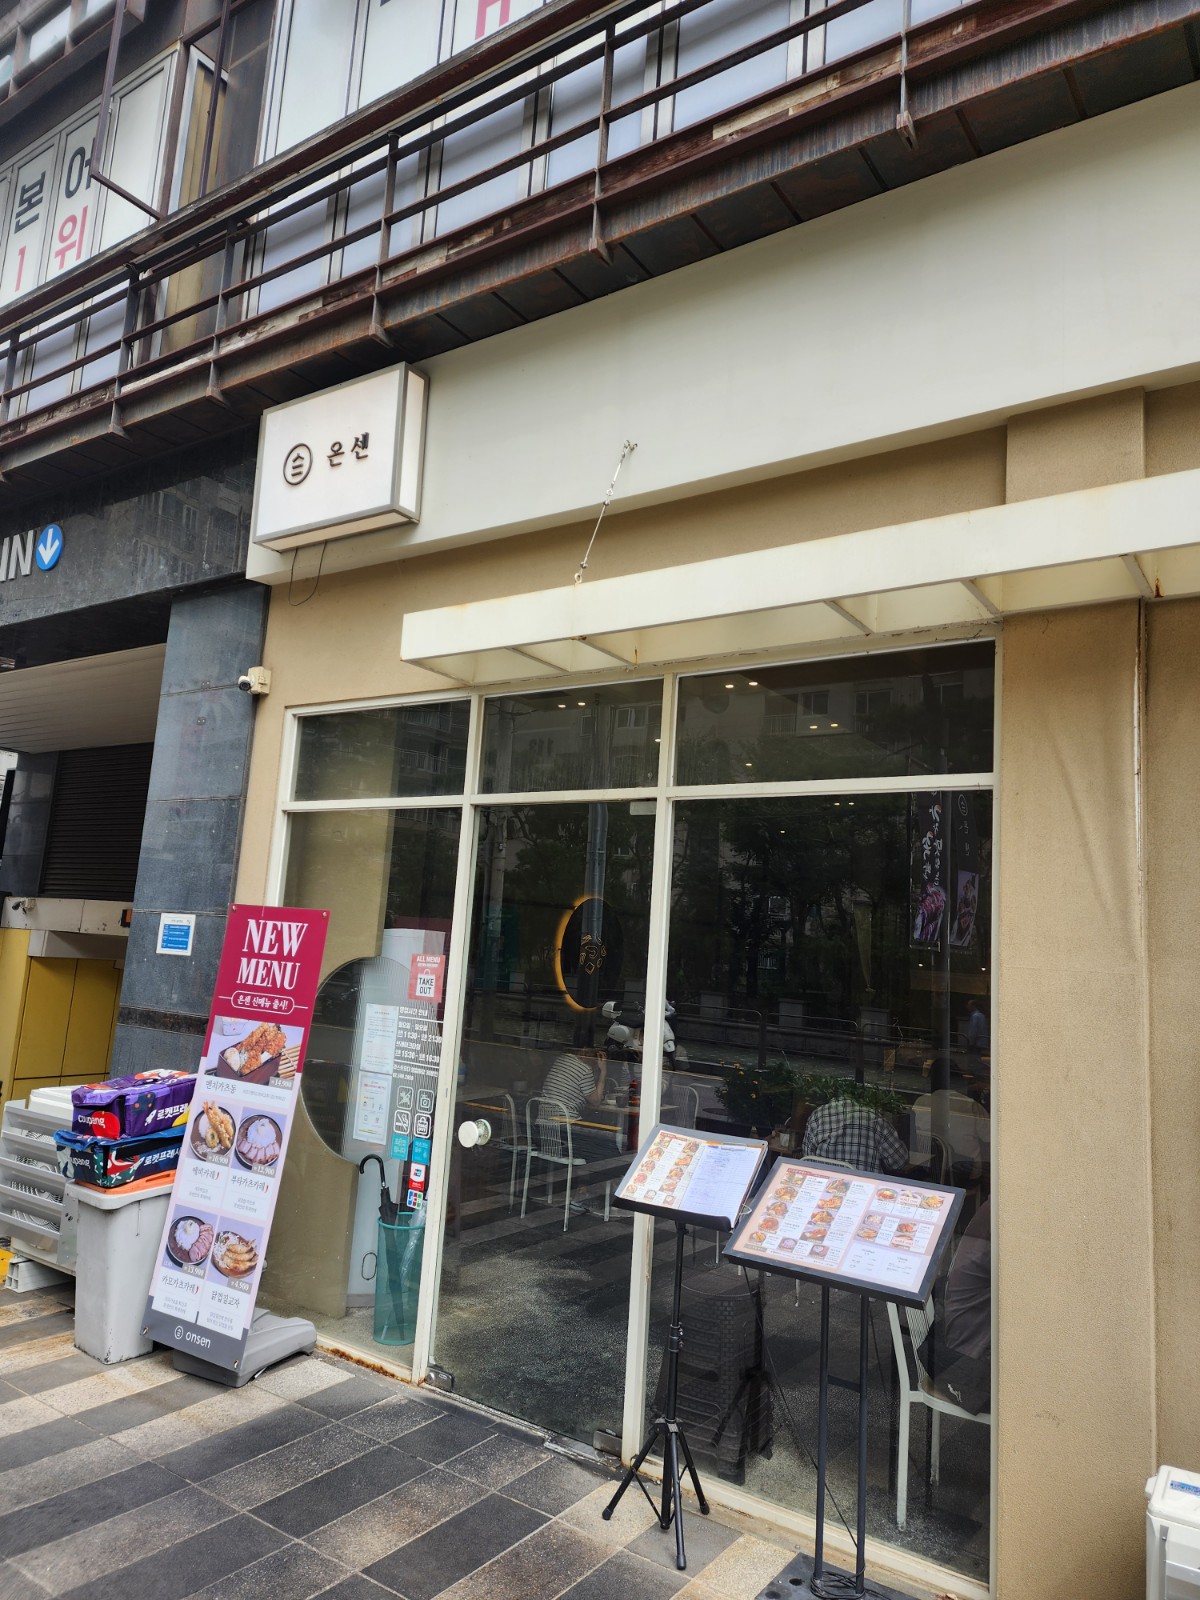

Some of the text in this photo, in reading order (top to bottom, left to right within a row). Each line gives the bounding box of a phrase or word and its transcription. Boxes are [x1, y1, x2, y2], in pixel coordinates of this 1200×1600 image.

[326, 431, 370, 469] 온센
[242, 919, 309, 957] NEW
[416, 955, 441, 964] ALL MENU
[236, 957, 300, 990] MENU
[418, 977, 434, 987] TAKE
[419, 986, 432, 995] OUT
[252, 997, 271, 1008] 신메뉴
[272, 1000, 289, 1010] 출시!
[157, 1102, 189, 1120] 로켓프레
[78, 1114, 105, 1128] coupang
[185, 1331, 211, 1348] onsen
